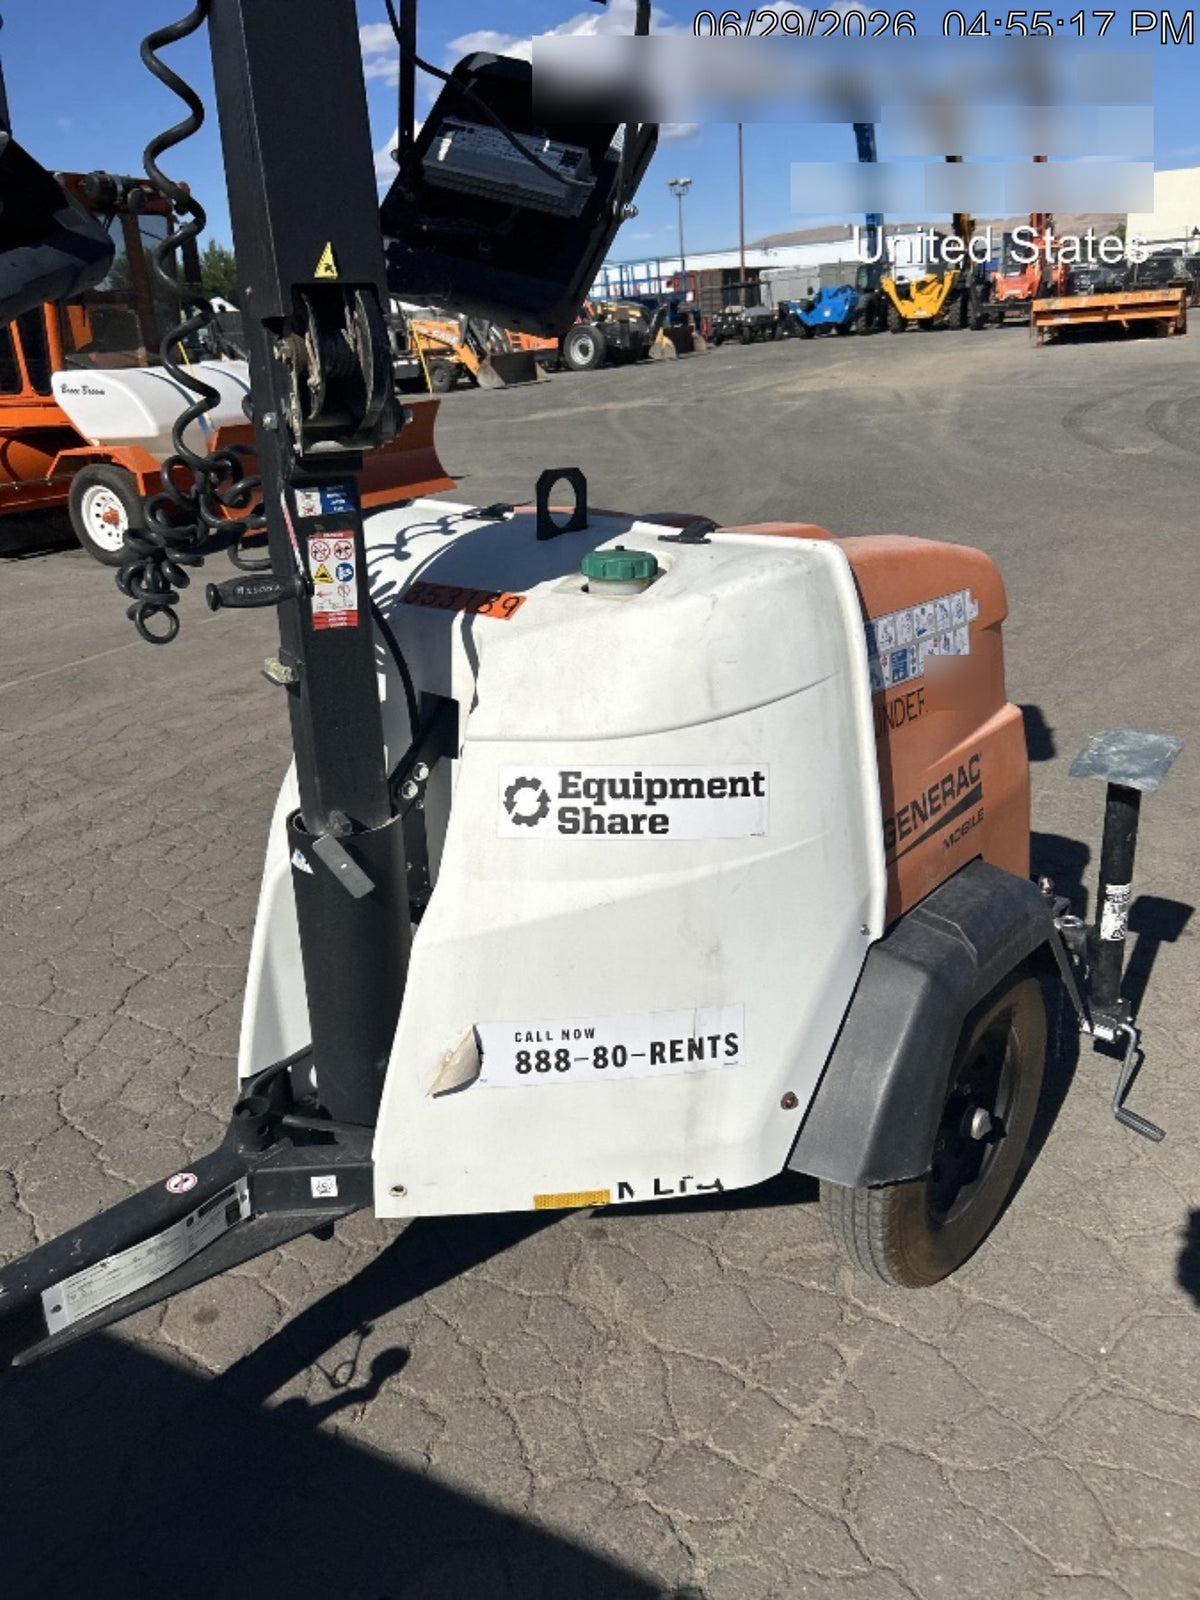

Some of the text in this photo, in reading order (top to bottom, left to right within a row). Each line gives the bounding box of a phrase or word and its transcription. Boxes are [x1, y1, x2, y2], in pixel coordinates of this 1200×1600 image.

[558, 771, 766, 806] Equipment
[883, 753, 981, 852] GENERAC
[557, 806, 670, 835] Share
[514, 1027, 596, 1043] CALL NOW
[514, 1032, 740, 1075] 888-80-RENTS
